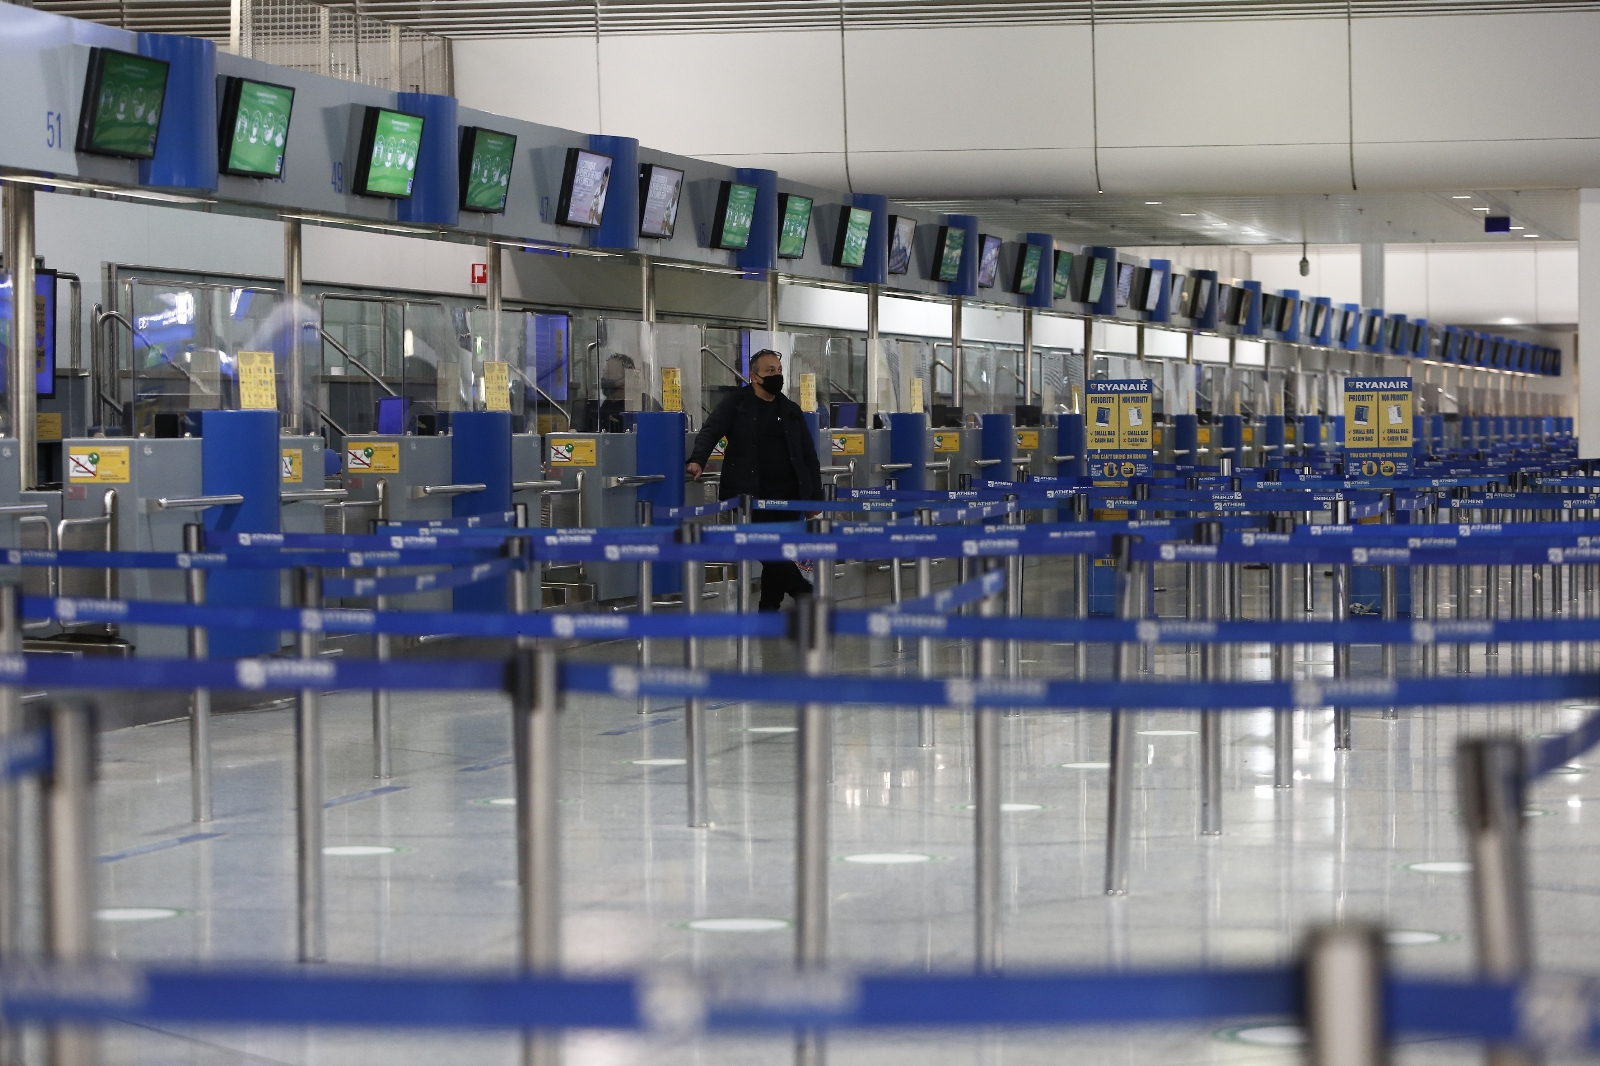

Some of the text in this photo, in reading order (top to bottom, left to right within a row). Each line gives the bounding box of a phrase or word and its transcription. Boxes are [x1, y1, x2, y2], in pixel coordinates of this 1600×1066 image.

[47, 111, 61, 149] 51
[331, 161, 342, 193] 49
[1097, 383, 1148, 391] RYANAIR
[1356, 381, 1408, 389] RYANAIR
[1091, 396, 1114, 404] PRIORITY
